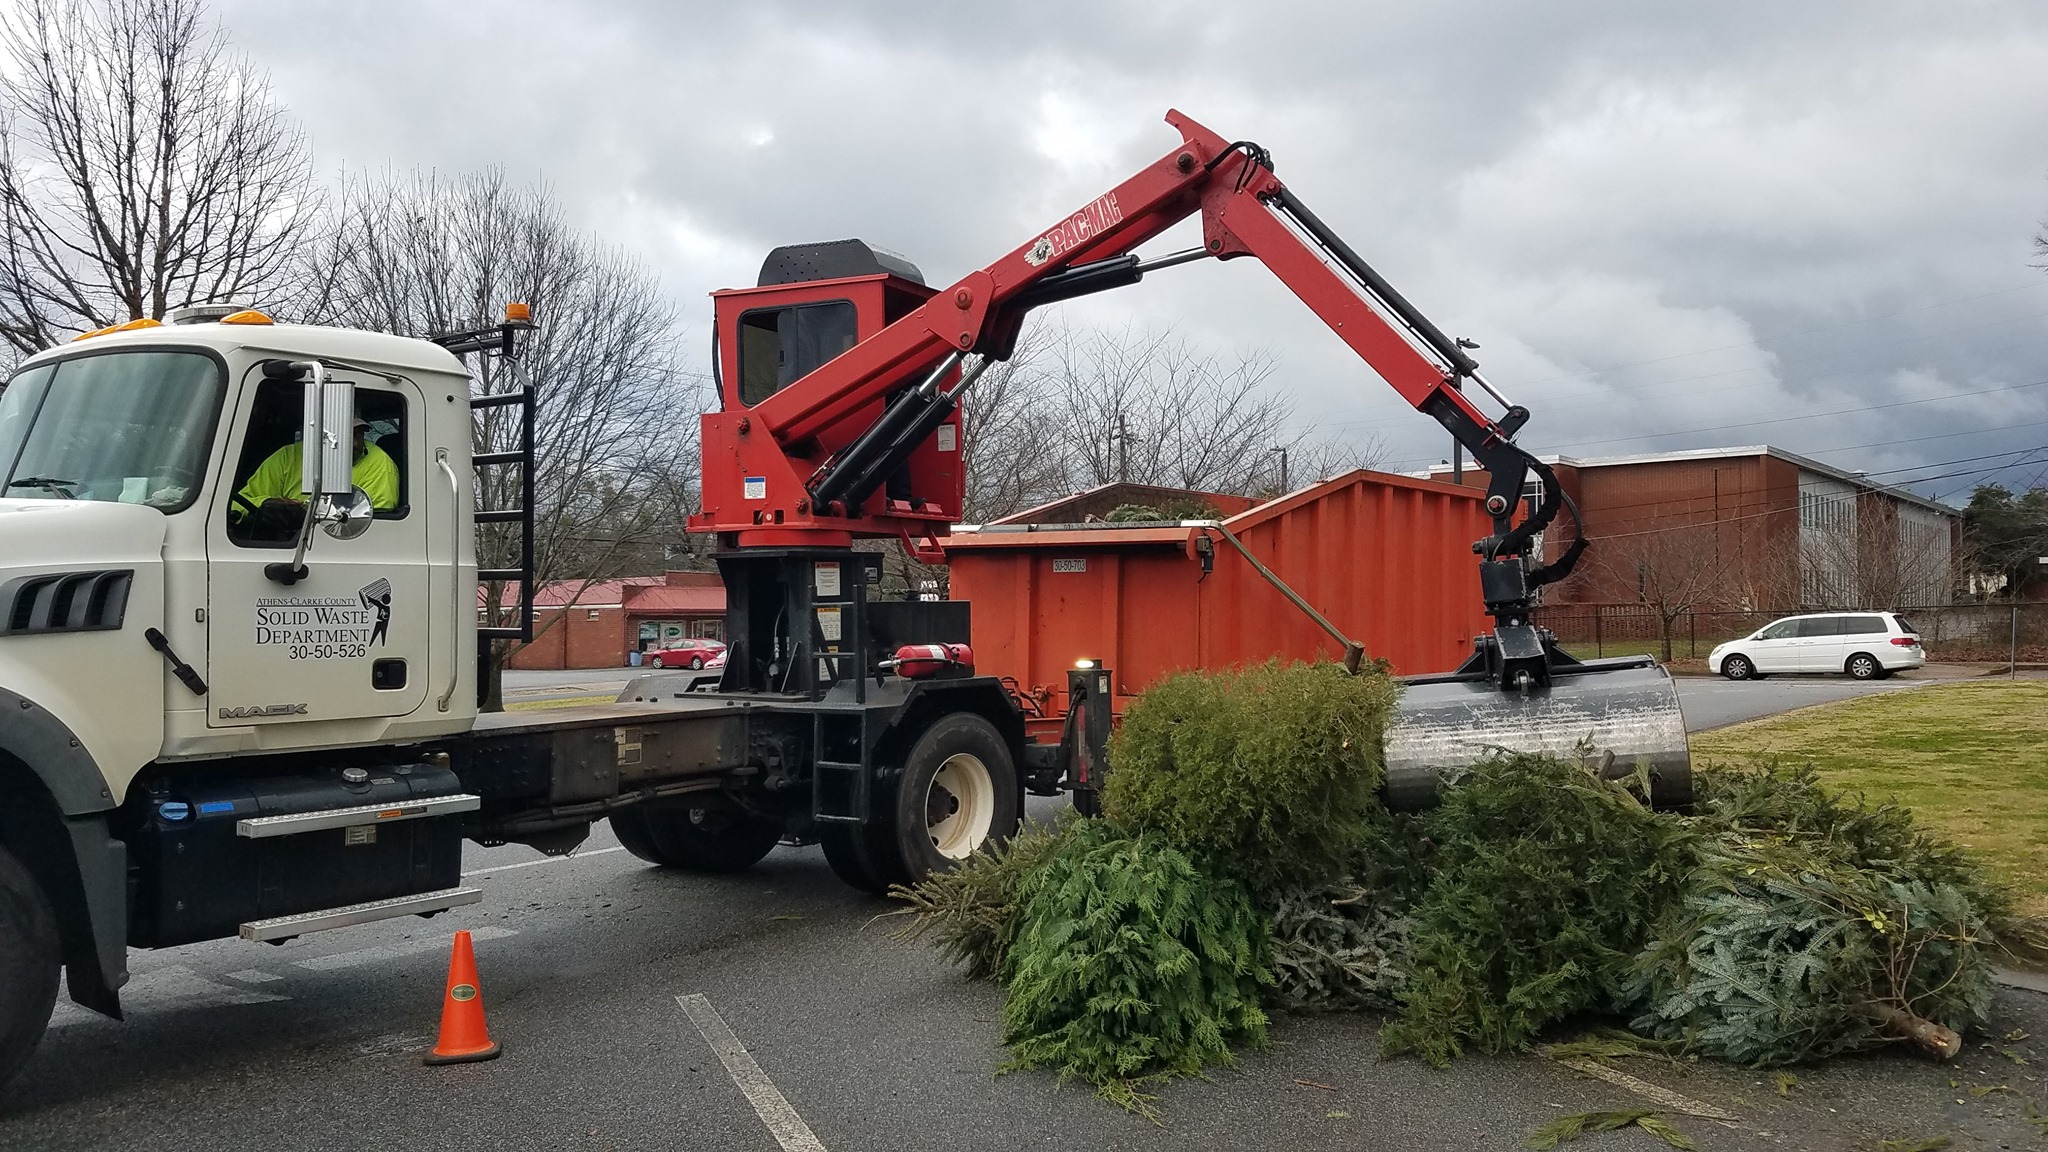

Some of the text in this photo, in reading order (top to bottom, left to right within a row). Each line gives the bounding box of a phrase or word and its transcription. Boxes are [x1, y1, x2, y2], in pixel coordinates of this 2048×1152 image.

[256, 597, 323, 605] ATHENS-CLARKE
[257, 607, 370, 626] SOLID WASTE
[256, 626, 370, 644] DEPARTMENT
[289, 644, 366, 660] 30-50-526
[219, 703, 308, 719] MACK
